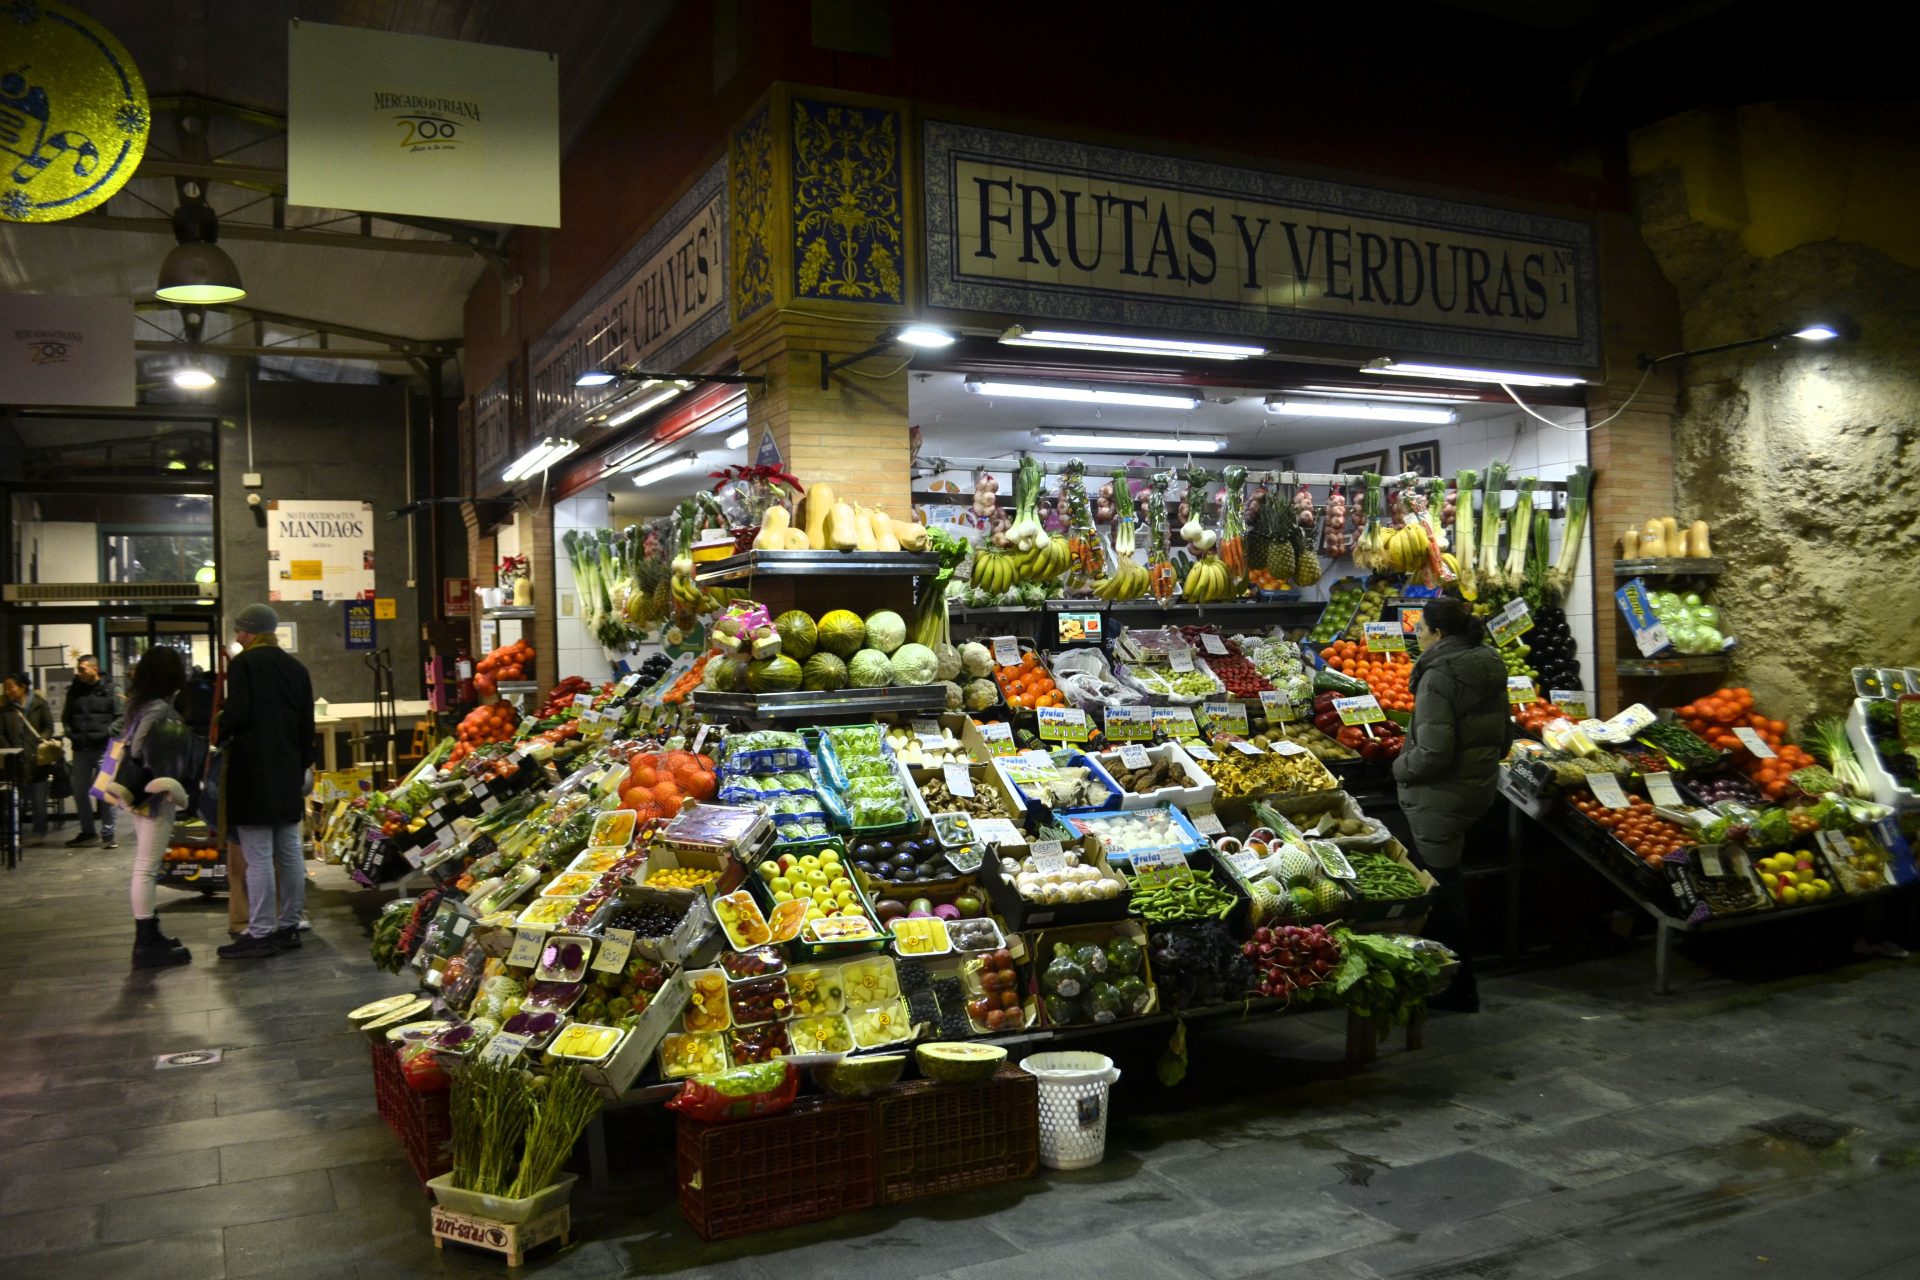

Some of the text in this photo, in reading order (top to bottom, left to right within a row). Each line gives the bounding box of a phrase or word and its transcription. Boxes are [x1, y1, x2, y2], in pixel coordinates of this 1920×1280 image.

[374, 91, 428, 111] MERCADO
[435, 98, 481, 121] TRIANA
[397, 120, 455, 147] 200
[712, 240, 719, 266] 1
[973, 176, 1549, 322] FRUTAS Y VERDURAS
[632, 222, 709, 352] CHAVES
[1559, 281, 1570, 305] 1
[279, 520, 363, 538] MANDAOS
[1040, 708, 1064, 718] Frutas
[1106, 708, 1131, 718] Frutas
[1151, 708, 1174, 718] Frutas
[1204, 703, 1228, 713] Frutas
[1133, 853, 1161, 865] Frutas
[435, 1218, 485, 1242] FRES-LUZ
